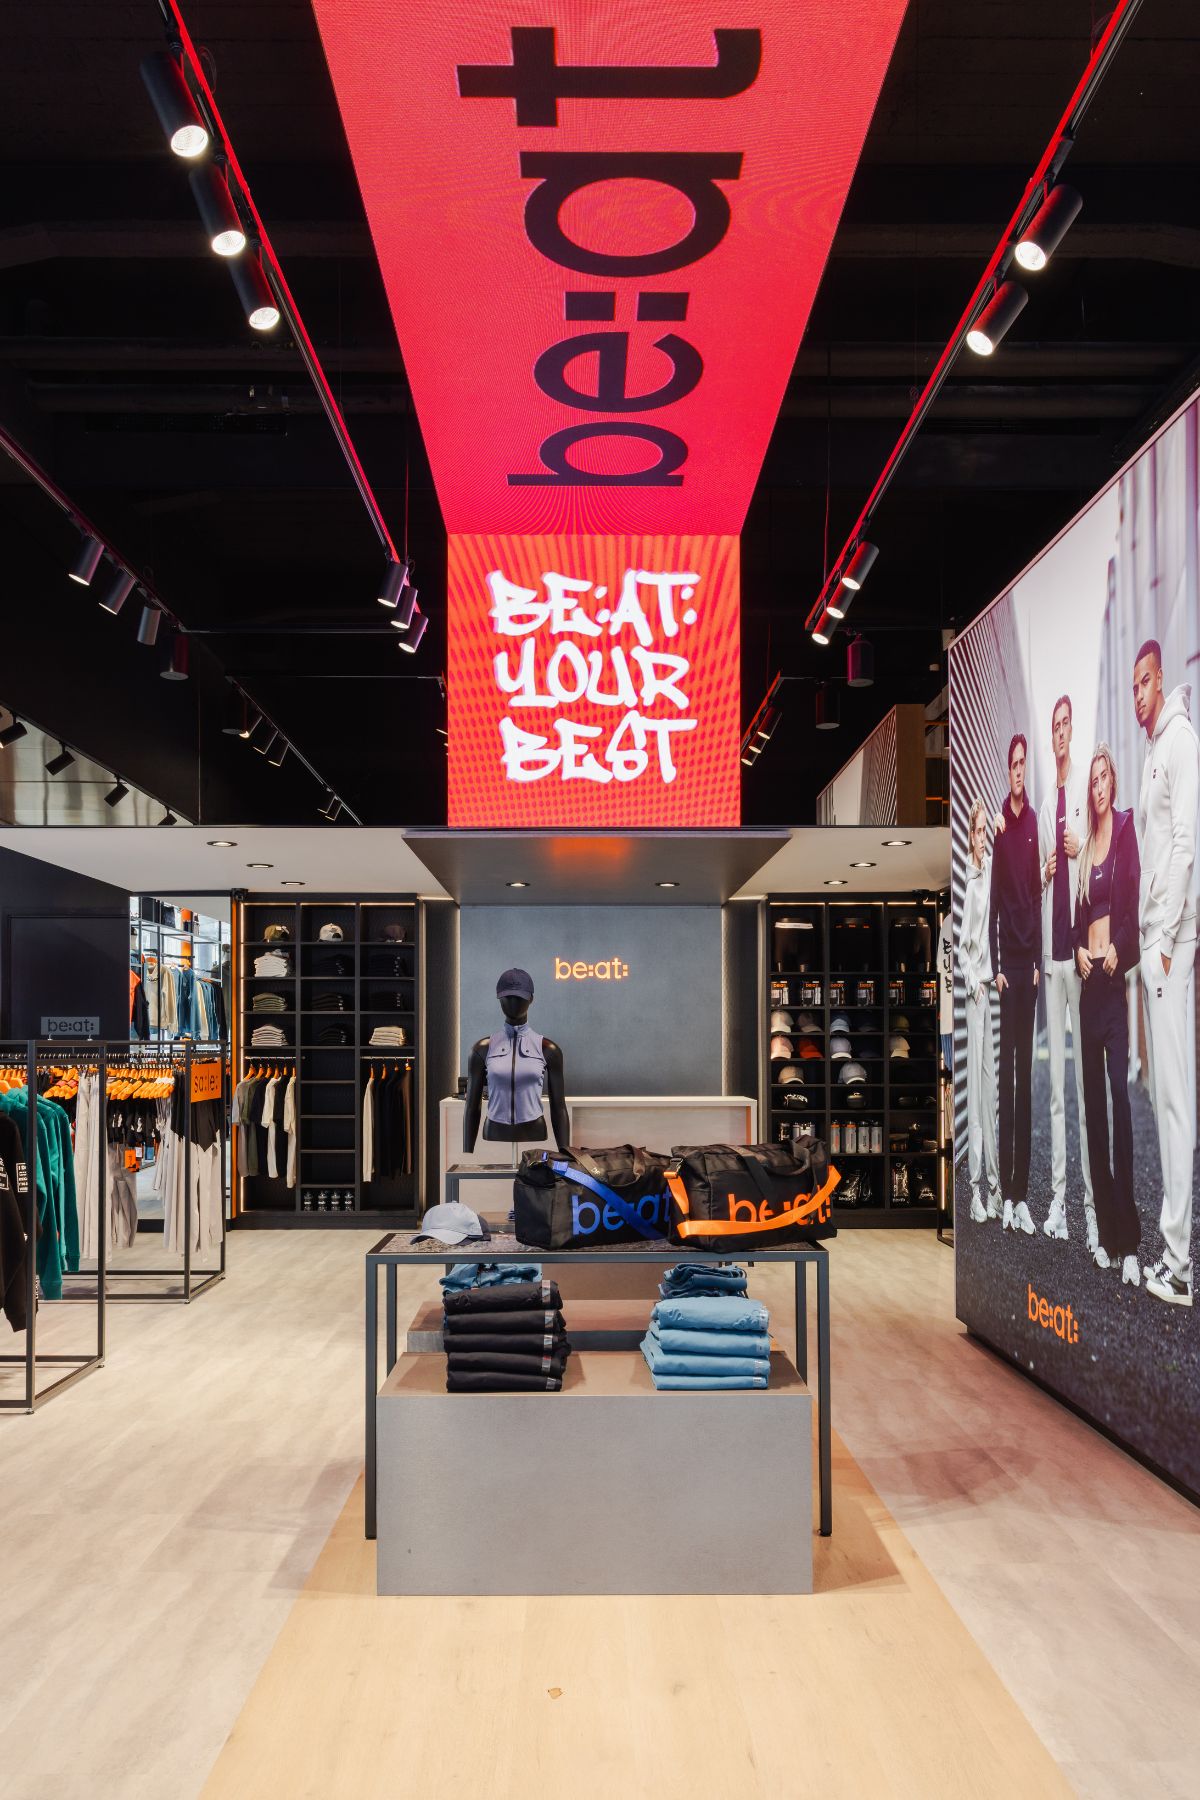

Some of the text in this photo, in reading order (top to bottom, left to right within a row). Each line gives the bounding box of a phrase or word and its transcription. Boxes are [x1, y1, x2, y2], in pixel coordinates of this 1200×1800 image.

[456, 26, 763, 487] be:at
[486, 568, 701, 646] BE:AT:
[493, 637, 690, 710] YOUR
[500, 710, 698, 783] BEST
[555, 957, 629, 979] be:at:
[47, 1019, 94, 1032] be:at:
[1027, 1284, 1079, 1344] be:at:
